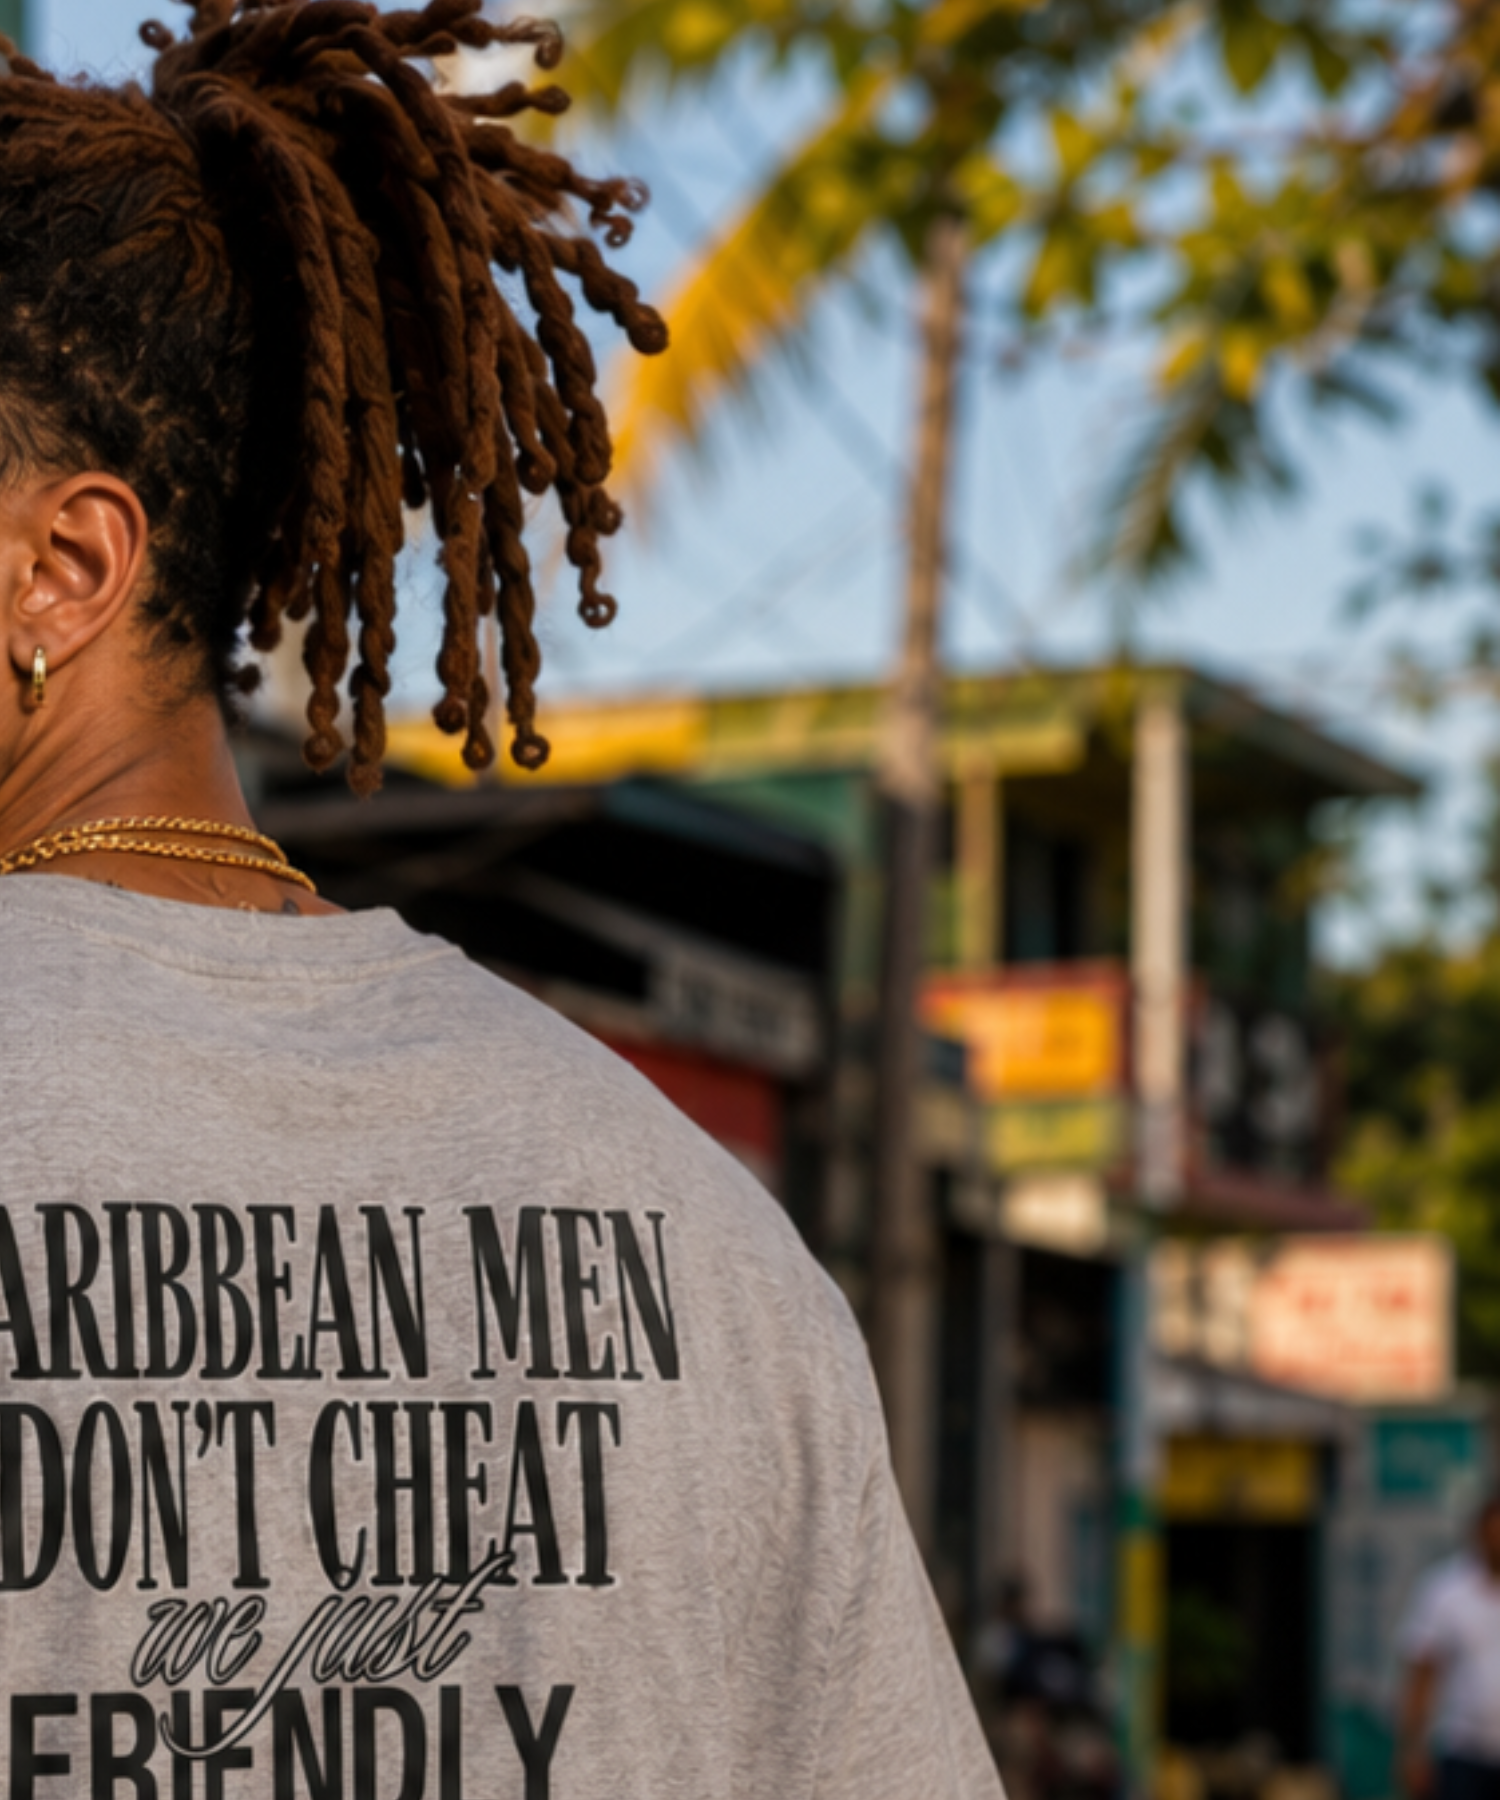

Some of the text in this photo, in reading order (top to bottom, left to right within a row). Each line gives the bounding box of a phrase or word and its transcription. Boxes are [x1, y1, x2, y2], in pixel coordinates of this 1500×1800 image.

[462, 1205, 680, 1380] MEN
[309, 1400, 621, 1588] CHEAT
[130, 1551, 516, 1760] we just
